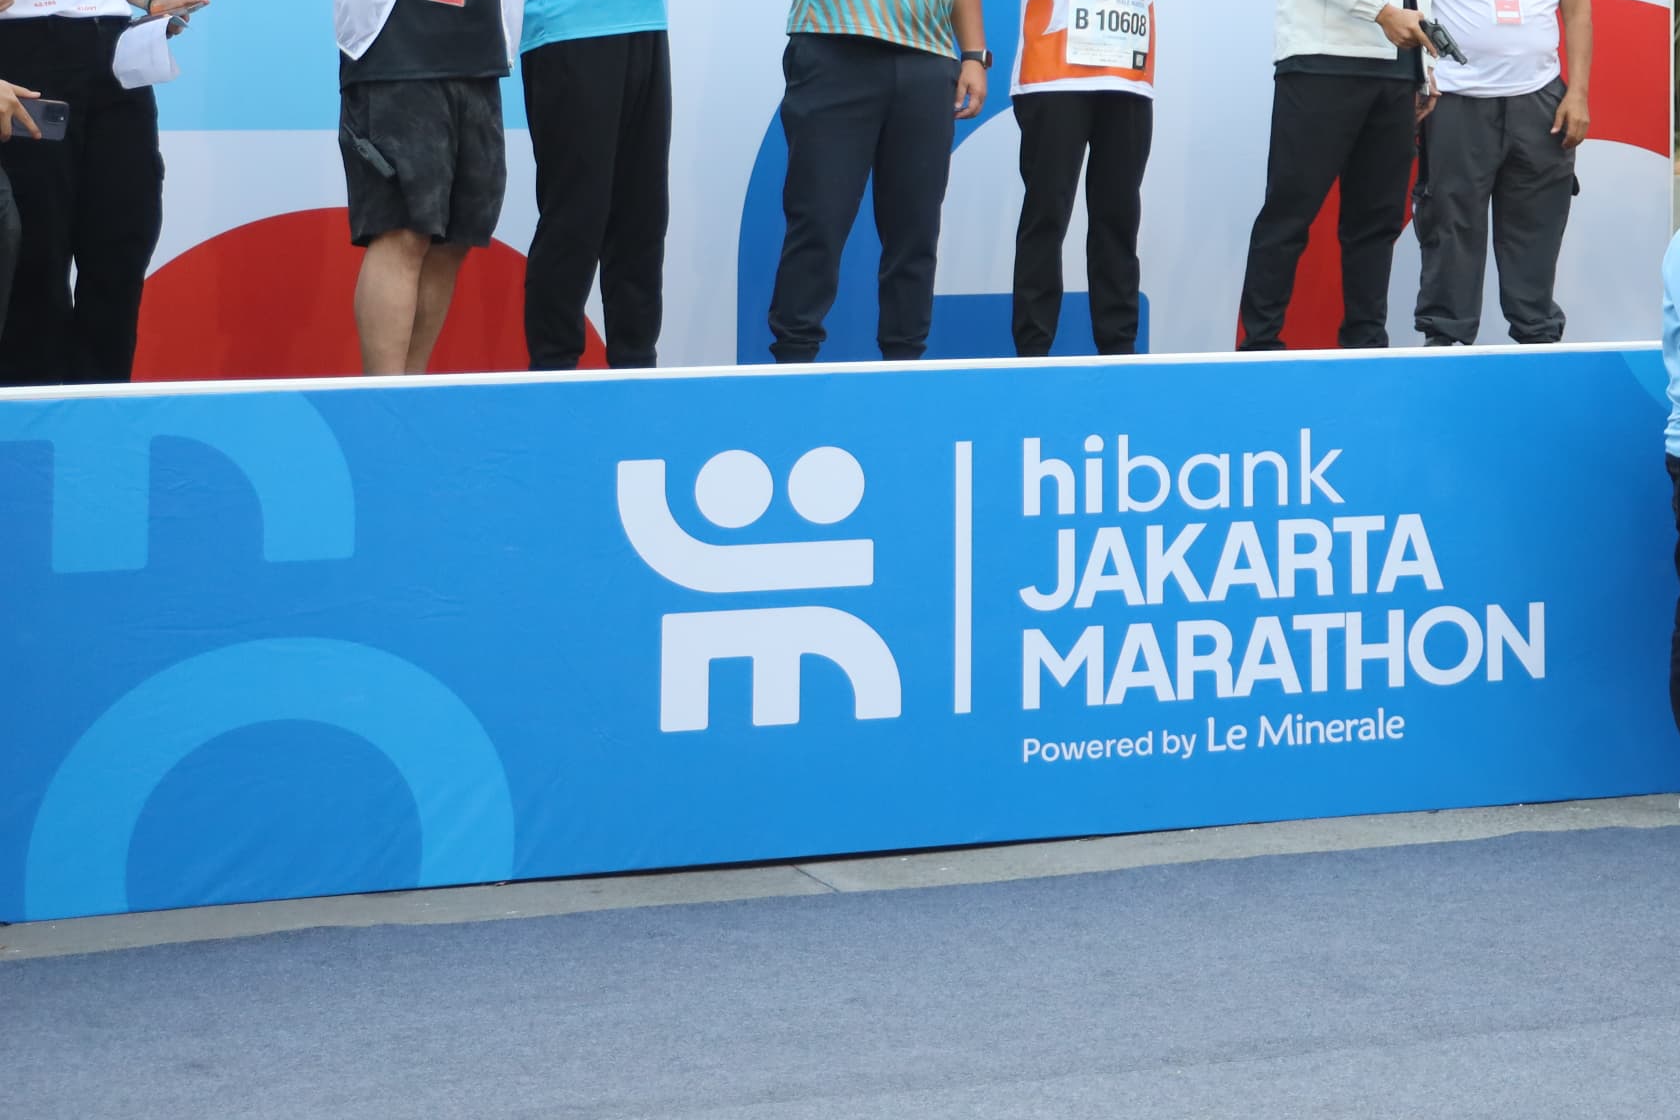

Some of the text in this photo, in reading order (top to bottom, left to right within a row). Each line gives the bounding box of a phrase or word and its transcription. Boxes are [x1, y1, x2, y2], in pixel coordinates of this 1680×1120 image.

[1075, 7, 1147, 37] B 10608
[1022, 427, 1345, 516] hibank
[1019, 513, 1445, 612] JAKARTA
[1022, 601, 1547, 711] MARATHON
[1022, 707, 1405, 763] Powered by Le Minerale
